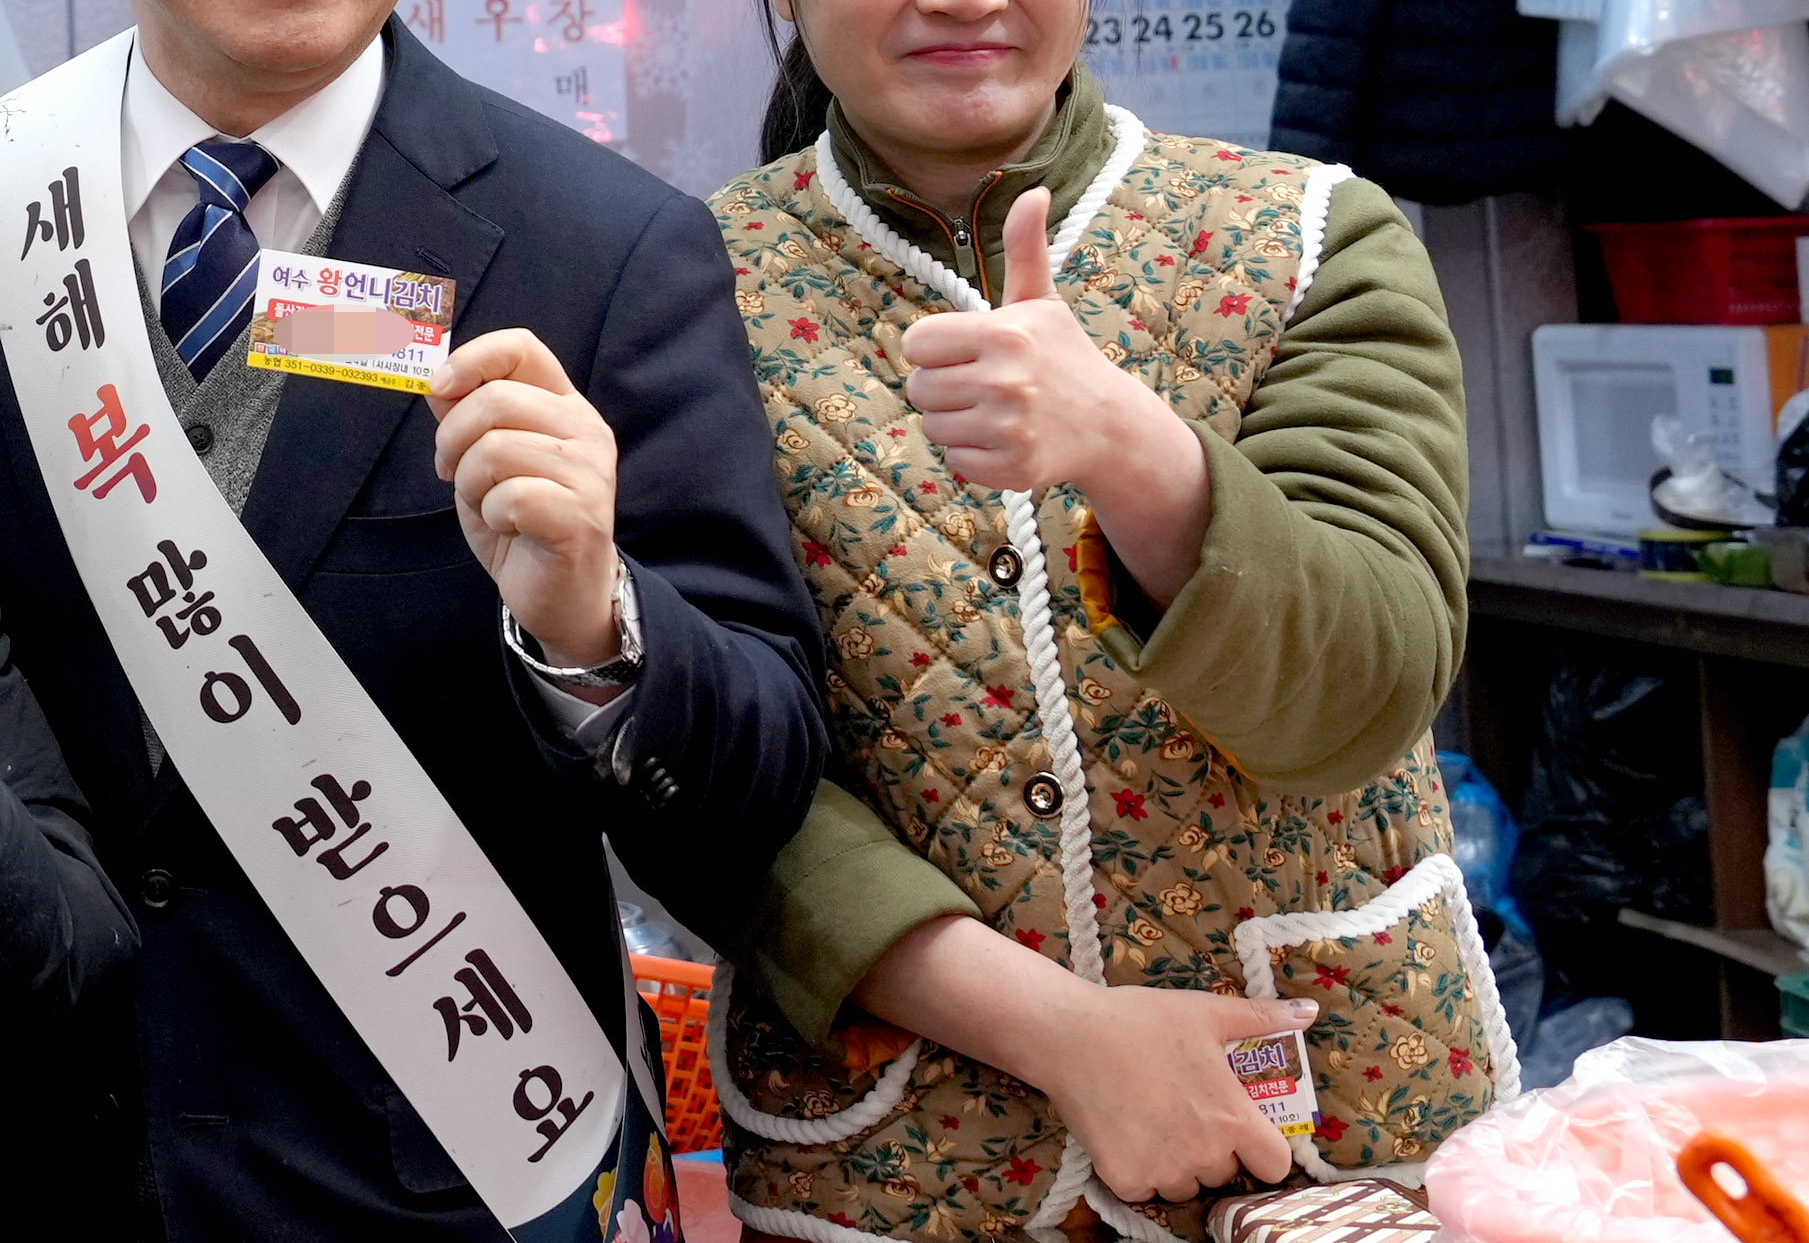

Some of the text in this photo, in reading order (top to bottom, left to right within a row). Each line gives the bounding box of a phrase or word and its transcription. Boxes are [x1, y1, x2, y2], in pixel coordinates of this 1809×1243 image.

[1131, 15, 1173, 42] 24
[1183, 13, 1224, 39] 25
[1233, 11, 1275, 37] 26
[272, 266, 310, 289] 여수
[21, 166, 594, 1162] 새해 복 많이 받으세요
